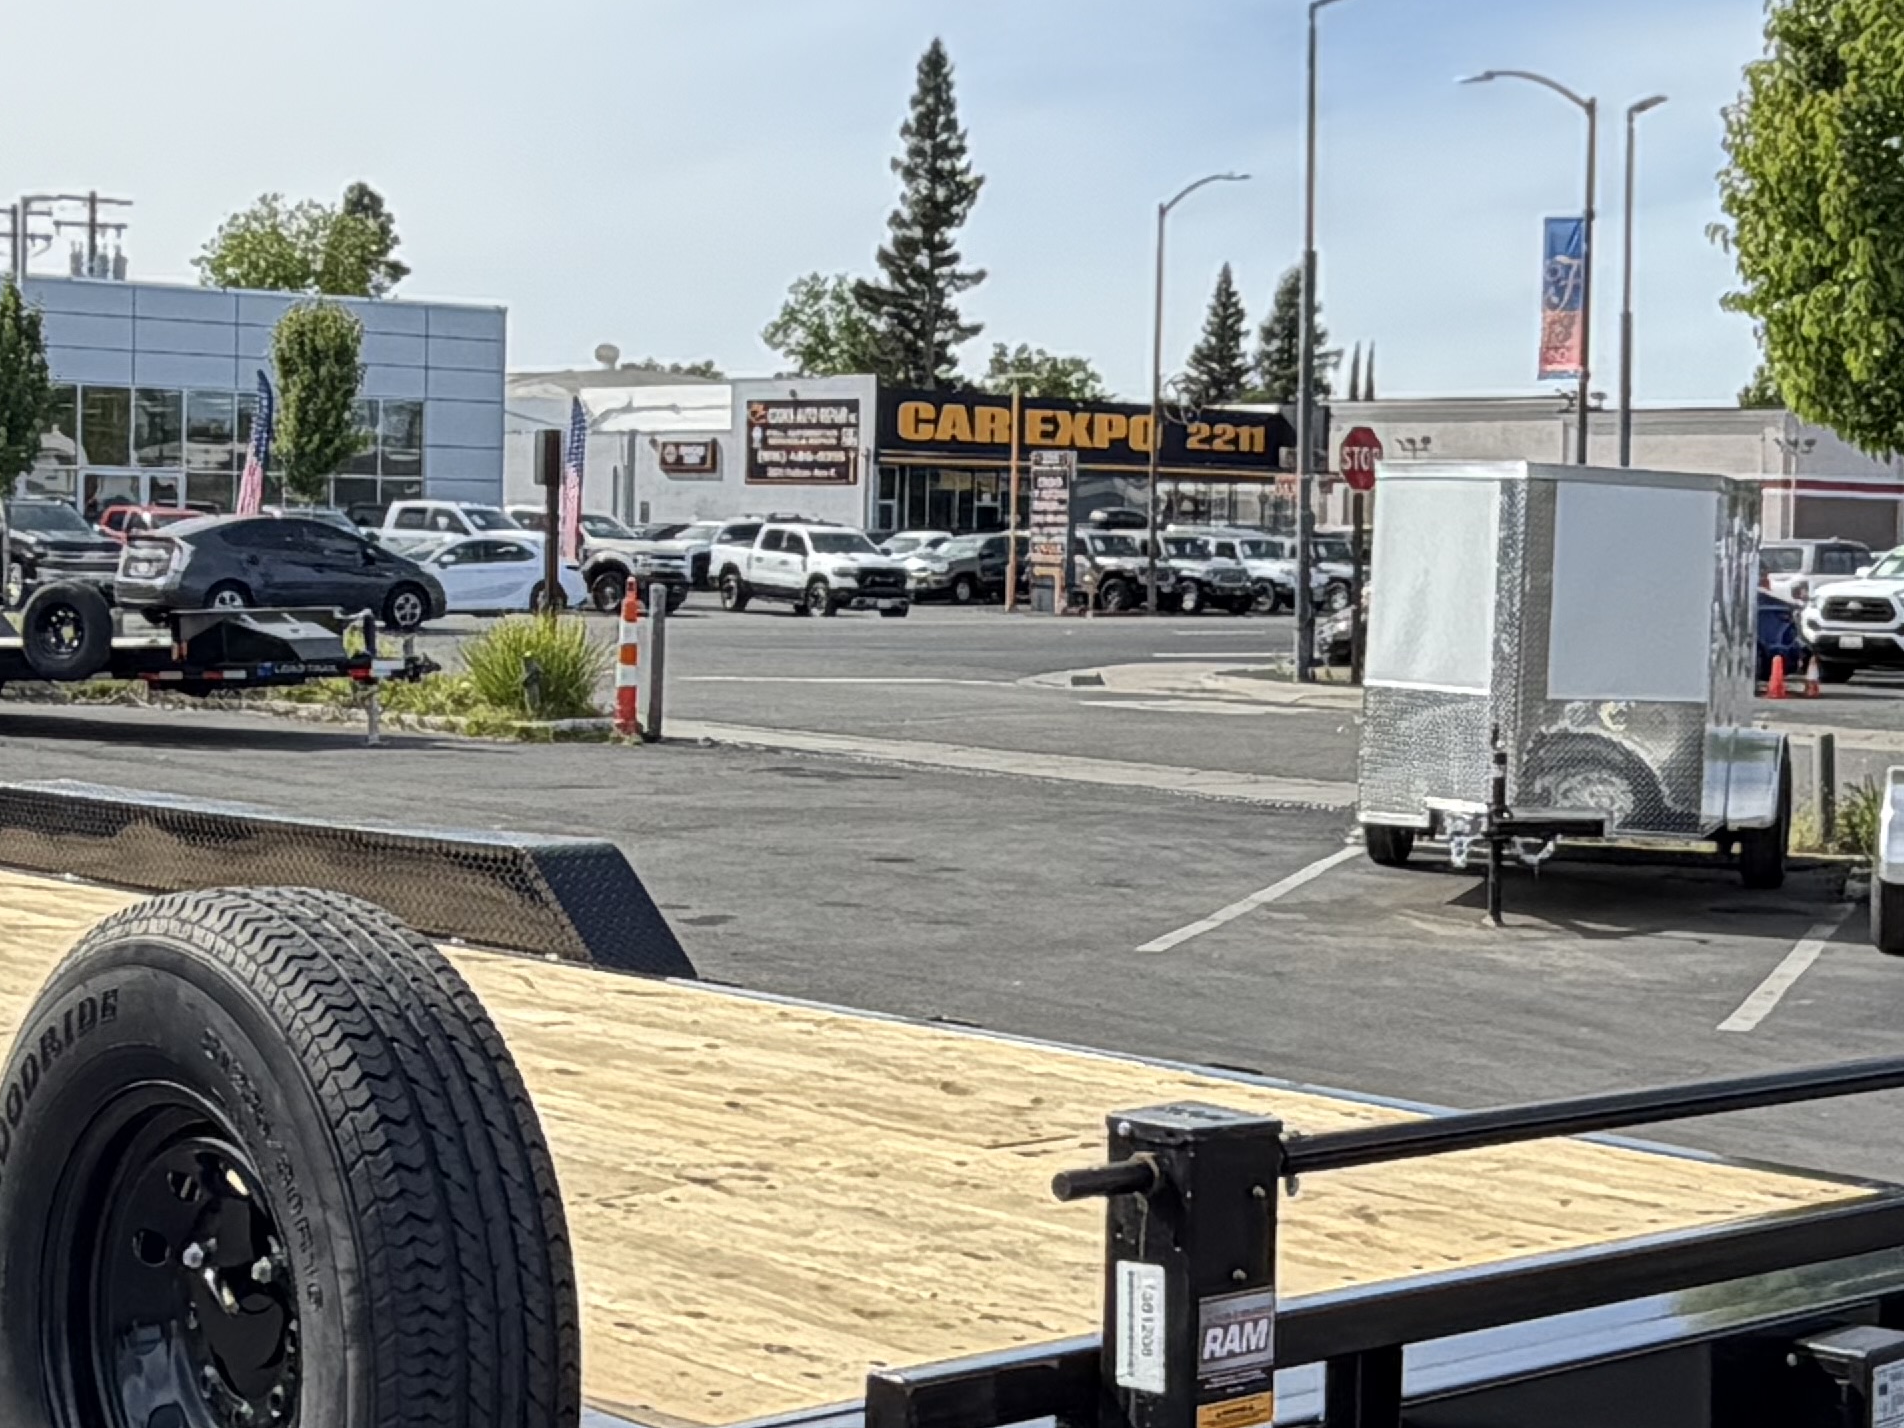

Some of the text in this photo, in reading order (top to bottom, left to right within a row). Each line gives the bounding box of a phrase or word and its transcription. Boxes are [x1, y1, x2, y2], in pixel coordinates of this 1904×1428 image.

[897, 401, 1010, 443] CAR
[1025, 408, 1163, 451] EXPO
[1186, 422, 1264, 452] 2211
[1202, 1318, 1268, 1360] RAM
